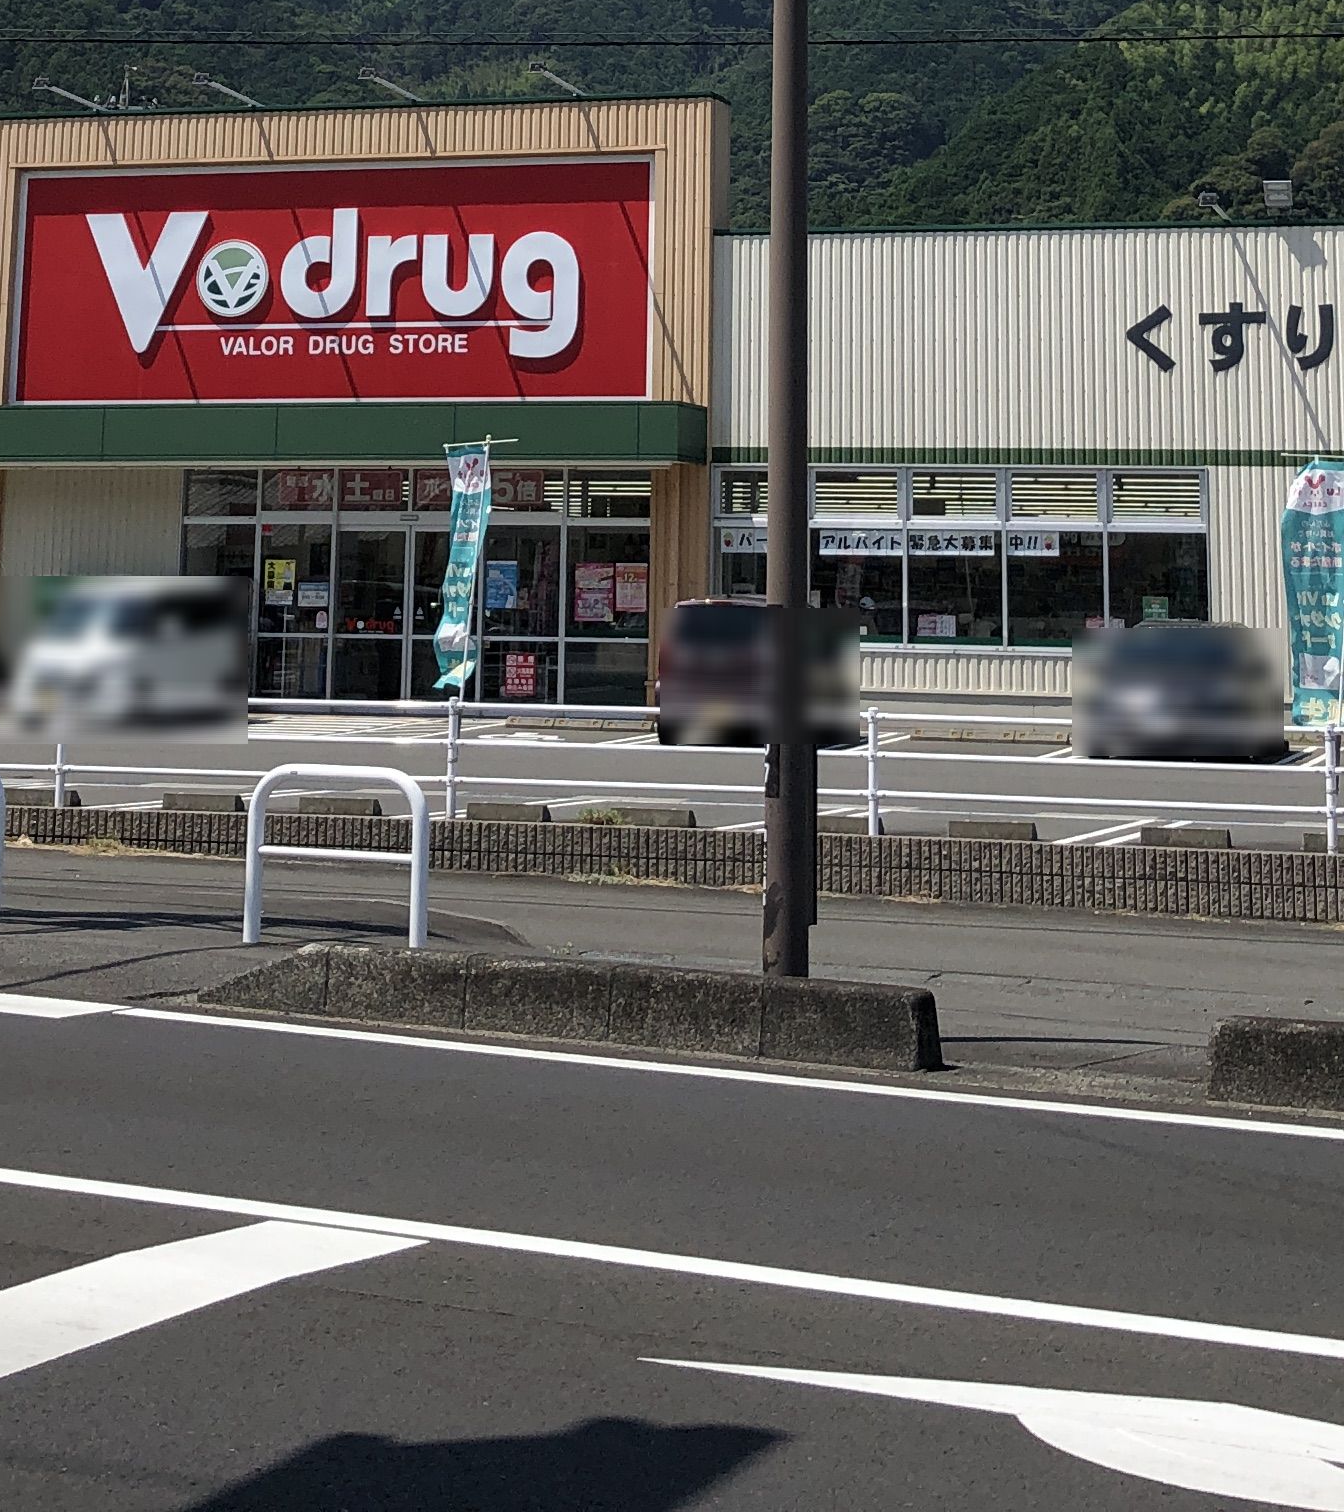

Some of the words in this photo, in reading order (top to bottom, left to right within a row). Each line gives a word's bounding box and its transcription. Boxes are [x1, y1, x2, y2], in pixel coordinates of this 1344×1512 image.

[220, 335, 294, 357] VALOR
[308, 335, 374, 356] DRUG
[389, 333, 469, 355] STORE
[1127, 301, 1335, 372] くすり
